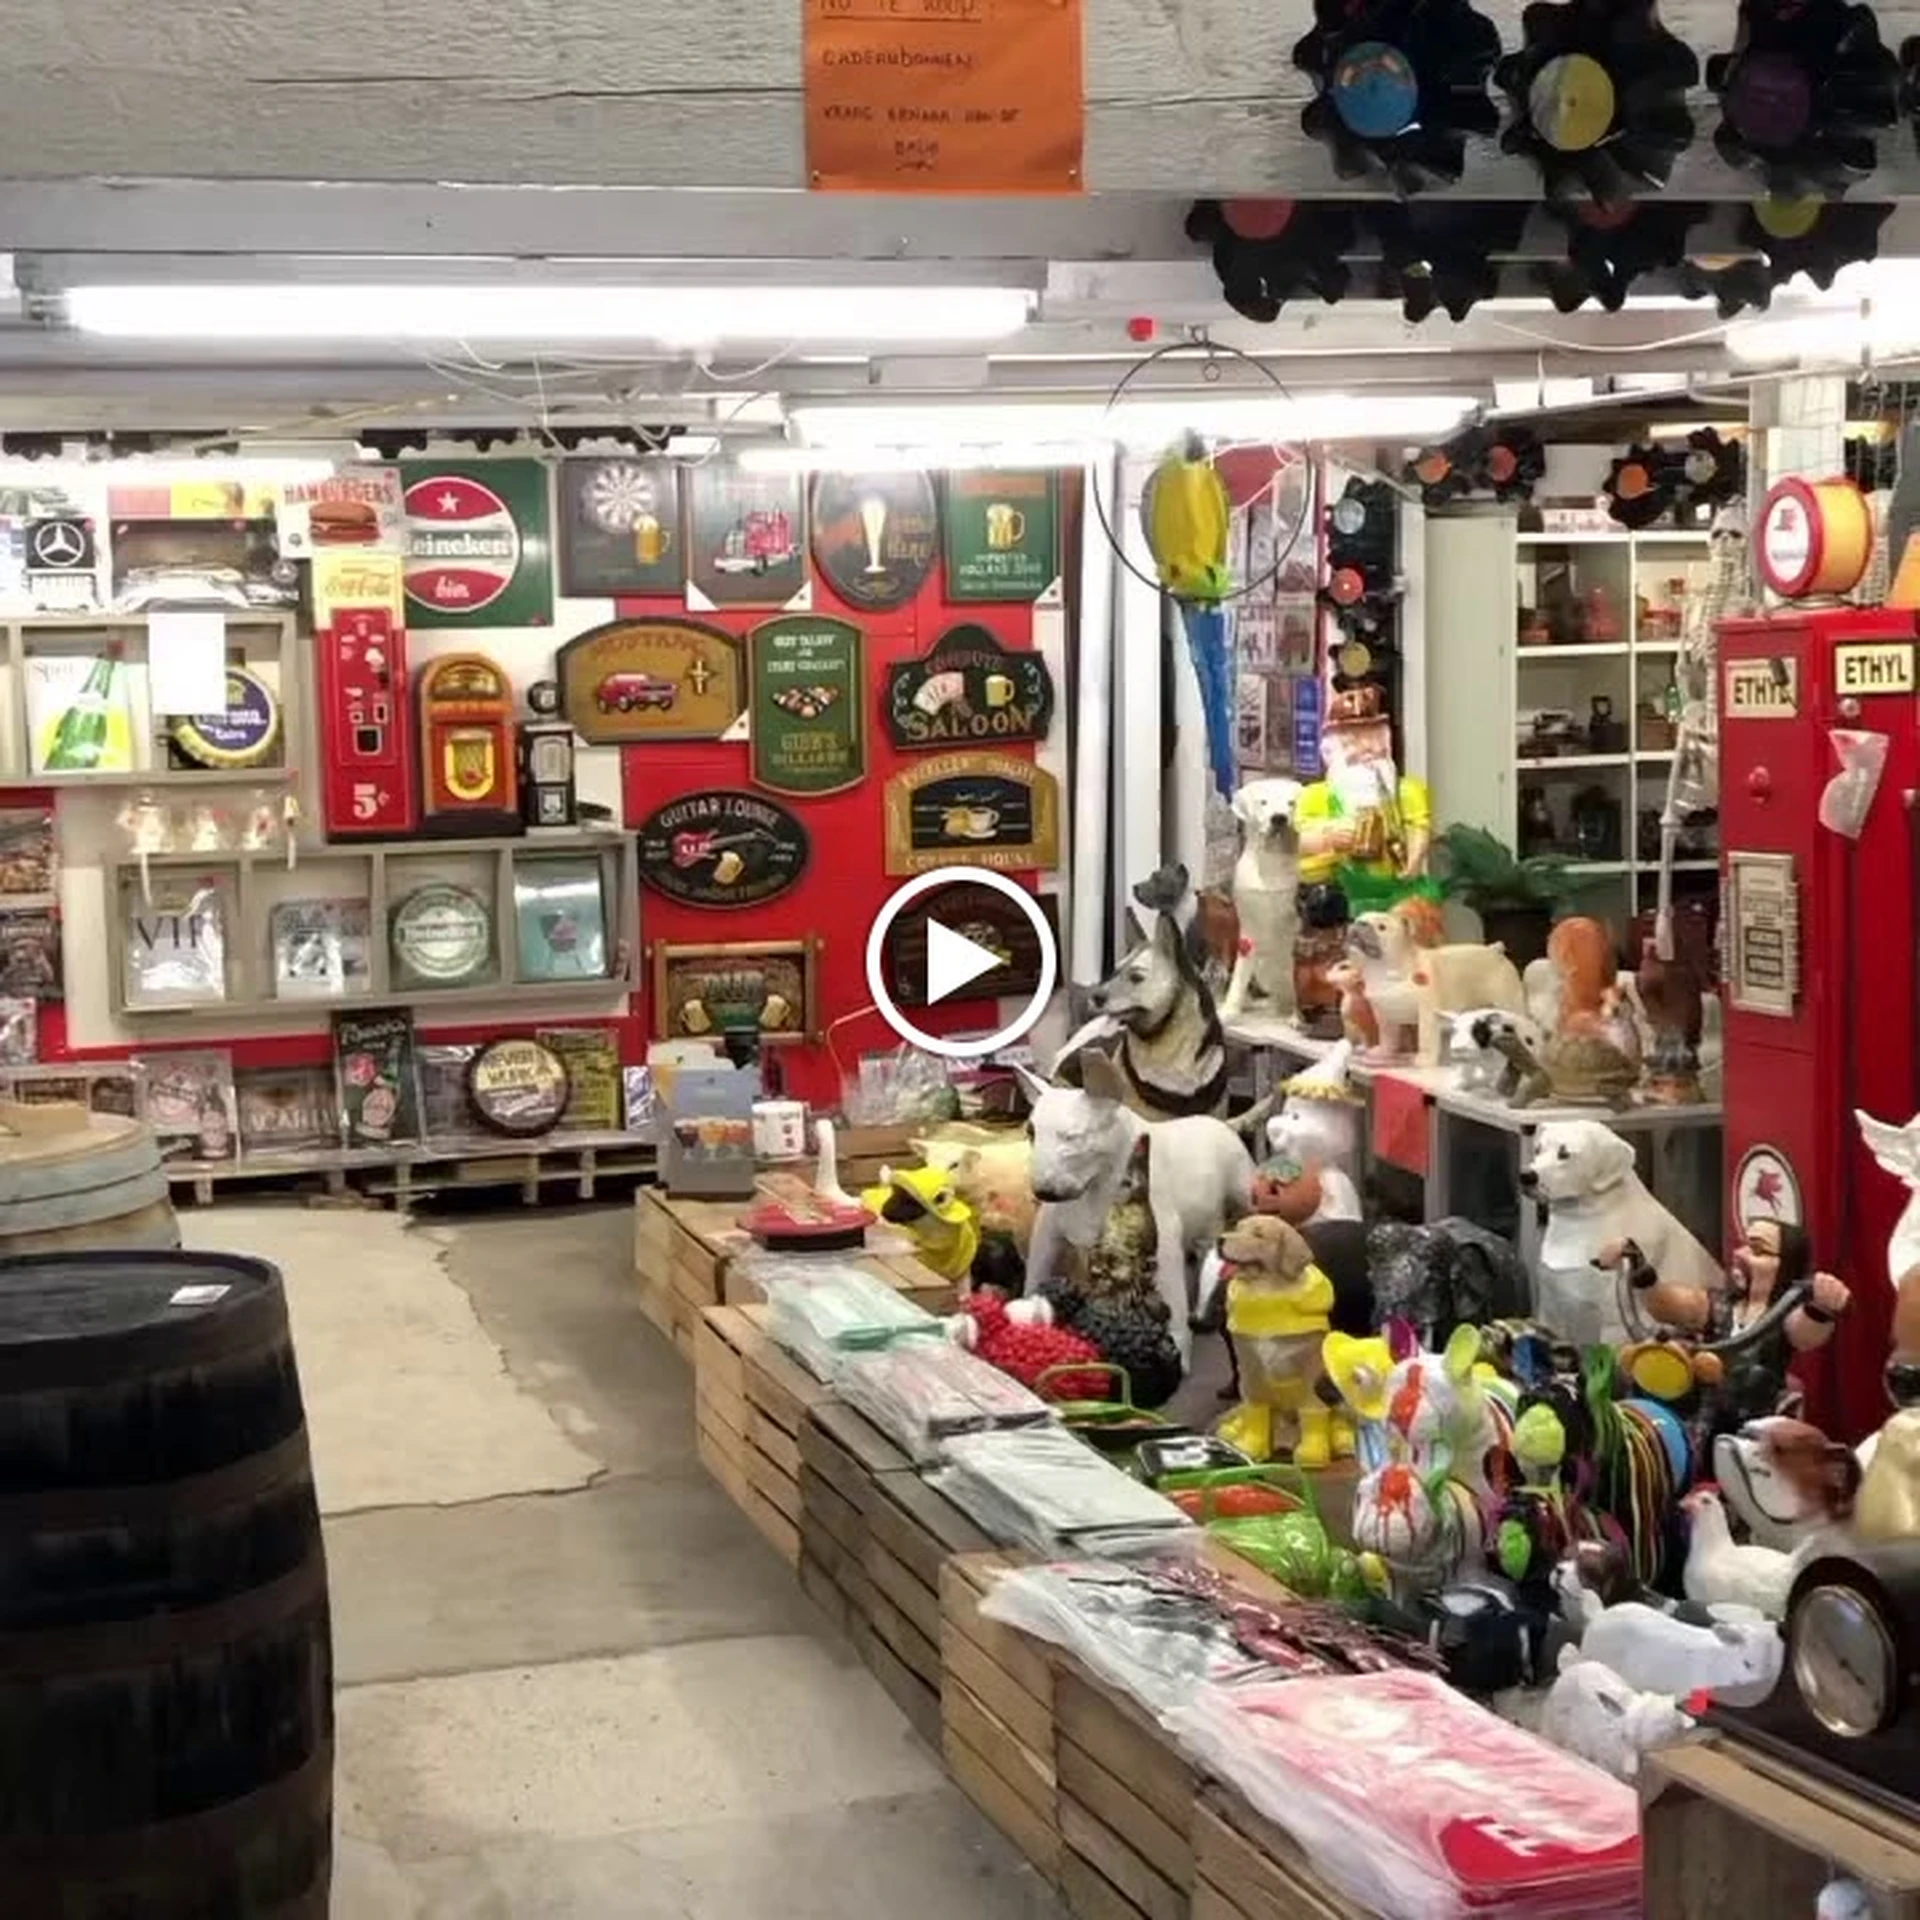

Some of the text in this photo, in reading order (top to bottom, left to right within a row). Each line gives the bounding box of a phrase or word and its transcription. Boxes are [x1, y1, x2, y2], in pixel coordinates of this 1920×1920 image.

[284, 480, 394, 505] HAMBURGERS
[404, 531, 512, 557] eineken
[1844, 654, 1908, 686] ETHYL
[906, 704, 1034, 740] SALOON
[660, 797, 780, 830] GUITAR LOUNGE
